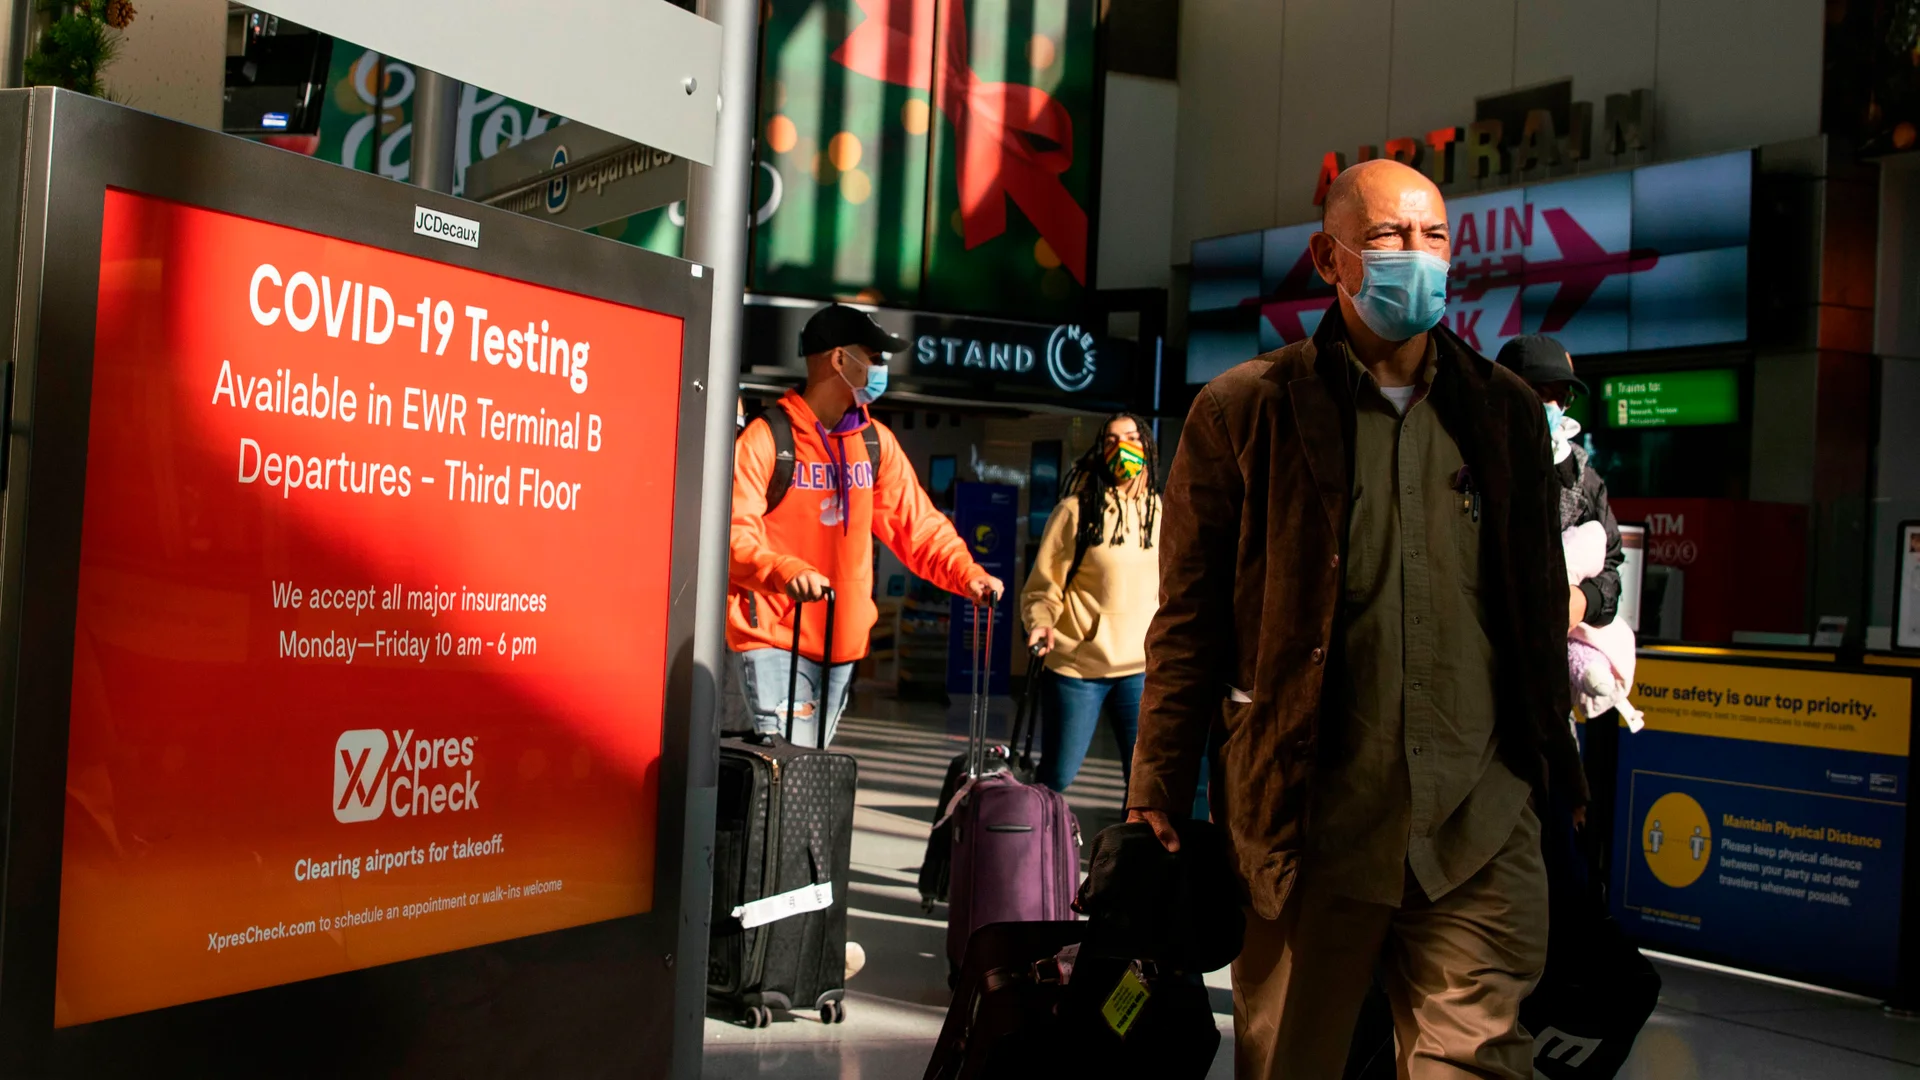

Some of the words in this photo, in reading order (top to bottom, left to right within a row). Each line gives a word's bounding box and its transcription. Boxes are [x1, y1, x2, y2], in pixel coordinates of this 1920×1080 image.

[416, 212, 477, 243] JCDecaux
[249, 263, 454, 356] COVID-19
[465, 305, 590, 394] Testing
[917, 335, 1036, 372] STAND
[212, 360, 357, 422] Available
[368, 382, 392, 426] in
[402, 387, 466, 436] EWR
[477, 397, 579, 449] Terminal
[588, 414, 602, 452] B
[1618, 382, 1646, 394] Trains
[238, 437, 411, 499] Departures
[445, 459, 510, 505] Third
[519, 467, 581, 511] Floor
[792, 460, 873, 491] LEMSON
[1645, 513, 1685, 535] ATM
[272, 580, 303, 609] We
[309, 585, 377, 616] accept
[381, 583, 401, 610] all
[407, 584, 456, 617] major
[461, 585, 547, 613] insurances
[435, 632, 452, 656] 10
[457, 636, 482, 656] am
[497, 632, 507, 656] 6
[511, 635, 537, 661] pm
[1637, 682, 1668, 699] Your
[1672, 687, 1723, 707] safety
[1726, 688, 1740, 705] is
[1744, 693, 1771, 709] our
[1776, 694, 1803, 713] top
[1807, 698, 1877, 721] priority.
[390, 729, 475, 773] Xpres
[390, 769, 481, 818] Check
[1723, 814, 1773, 833] Maintain
[1776, 821, 1825, 840] Physical
[1827, 828, 1882, 849] Distance
[294, 853, 361, 881] Clearing
[366, 846, 425, 874] airports
[429, 842, 449, 863] for
[452, 833, 504, 859] takeoff.
[1720, 856, 1760, 873] between
[1761, 864, 1783, 877] your
[1784, 868, 1811, 882] party
[1812, 872, 1831, 884] and
[1833, 875, 1860, 889] other
[1721, 838, 1752, 854] Please
[1754, 844, 1777, 859] keep
[1778, 848, 1818, 865] physical
[1820, 853, 1862, 871] distance
[1719, 874, 1759, 890] travelers
[1761, 881, 1805, 898] whenever
[1808, 890, 1852, 907] possible.
[207, 920, 316, 953] XpresCheck.com
[319, 916, 331, 931] to
[334, 906, 383, 928] schedule
[386, 907, 400, 920] an
[402, 892, 467, 919] appointment
[469, 894, 479, 905] or
[482, 884, 521, 903] walk-ins
[523, 879, 562, 896] welcome
